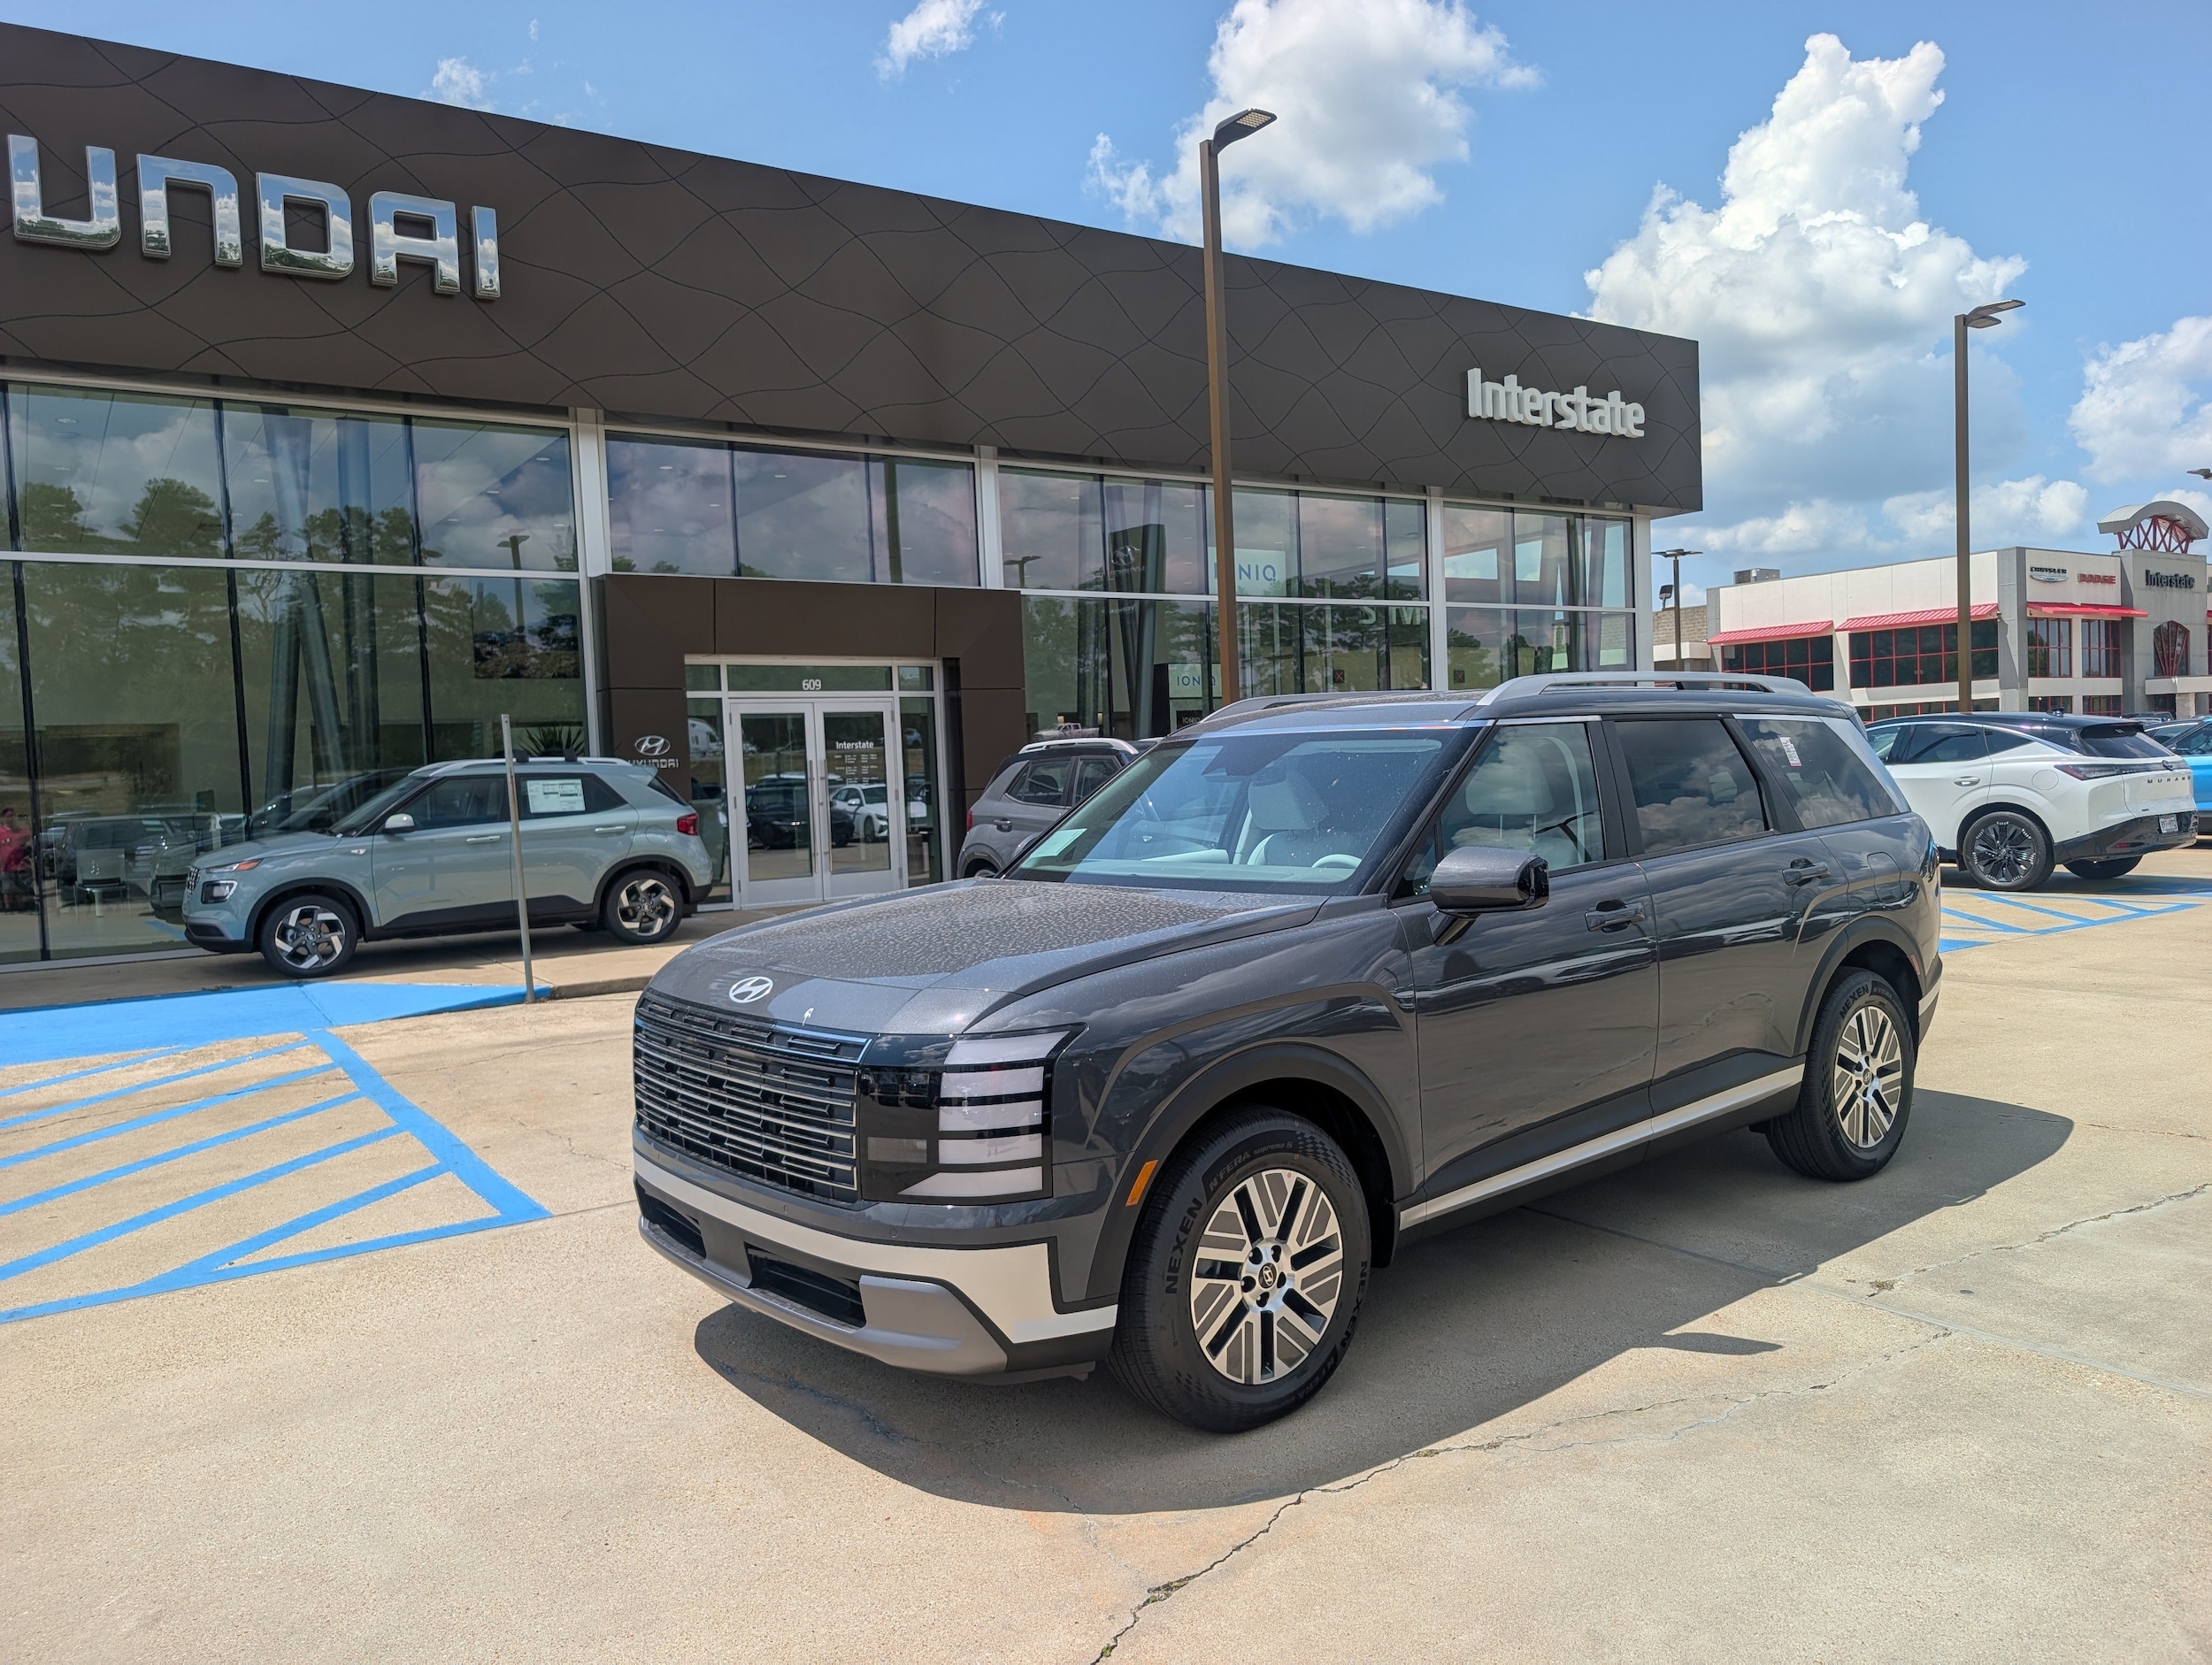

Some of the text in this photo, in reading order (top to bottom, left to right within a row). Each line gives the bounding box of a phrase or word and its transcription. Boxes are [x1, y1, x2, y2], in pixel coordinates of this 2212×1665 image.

[8, 134, 501, 299] UNDAI
[1467, 368, 1645, 438] Interstate
[1214, 563, 1276, 582] INIQ
[2078, 573, 2116, 585] DODGE
[2145, 570, 2195, 589] Interstate
[803, 679, 821, 690] 609
[1177, 675, 1216, 687] IONQ
[835, 740, 874, 749] Interstate
[1839, 984, 1869, 1019] NEXEN
[1209, 1151, 1251, 1192] N'FERA
[1165, 1197, 1203, 1294] NEXEN
[1340, 1261, 1368, 1347] NEXEN
